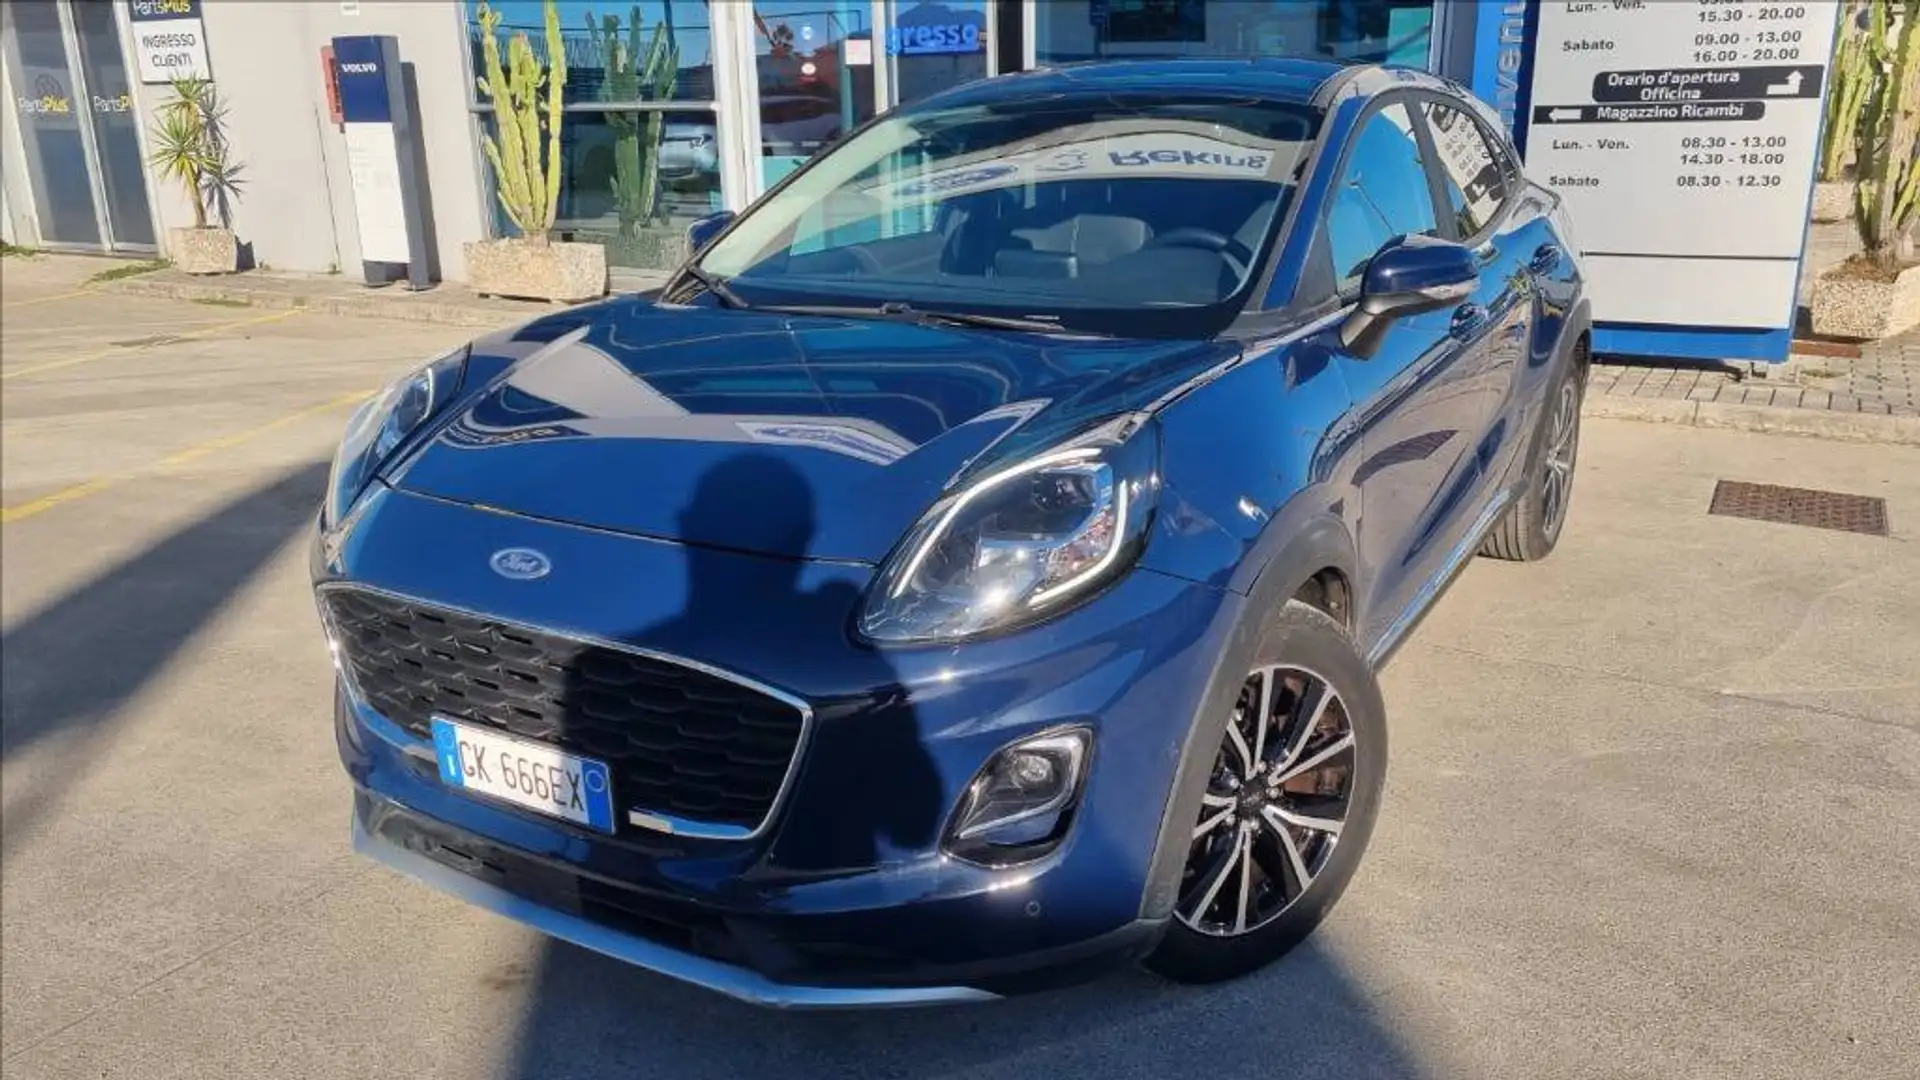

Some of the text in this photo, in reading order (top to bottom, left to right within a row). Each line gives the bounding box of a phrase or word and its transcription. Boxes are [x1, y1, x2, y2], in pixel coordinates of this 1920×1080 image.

[1699, 9, 1743, 23] 15.30
[1758, 7, 1806, 20] 20.00
[142, 33, 197, 48] INGRESSO
[1695, 33, 1740, 46] 09.00
[1756, 30, 1802, 44] 13.00
[1563, 39, 1615, 52] Sabato
[152, 53, 192, 67] CLIENTI
[1693, 50, 1737, 63] 16.00
[1753, 47, 1799, 61] 20.00
[341, 62, 377, 73] VOLVO
[1608, 70, 1740, 90] Orario d'apertura
[1640, 87, 1701, 101] Officina
[1597, 102, 1744, 121] Magazzino Ricambi
[1552, 138, 1582, 150] Lun.
[1681, 136, 1726, 149] 08.30
[1743, 136, 1787, 148] 13.00
[1680, 153, 1724, 165] 14.30
[1740, 152, 1785, 165] 18.00
[1549, 175, 1600, 187] Sabato
[1676, 175, 1721, 187] 08.30
[1737, 174, 1782, 187] 12.30
[499, 752, 585, 812] 666EX
